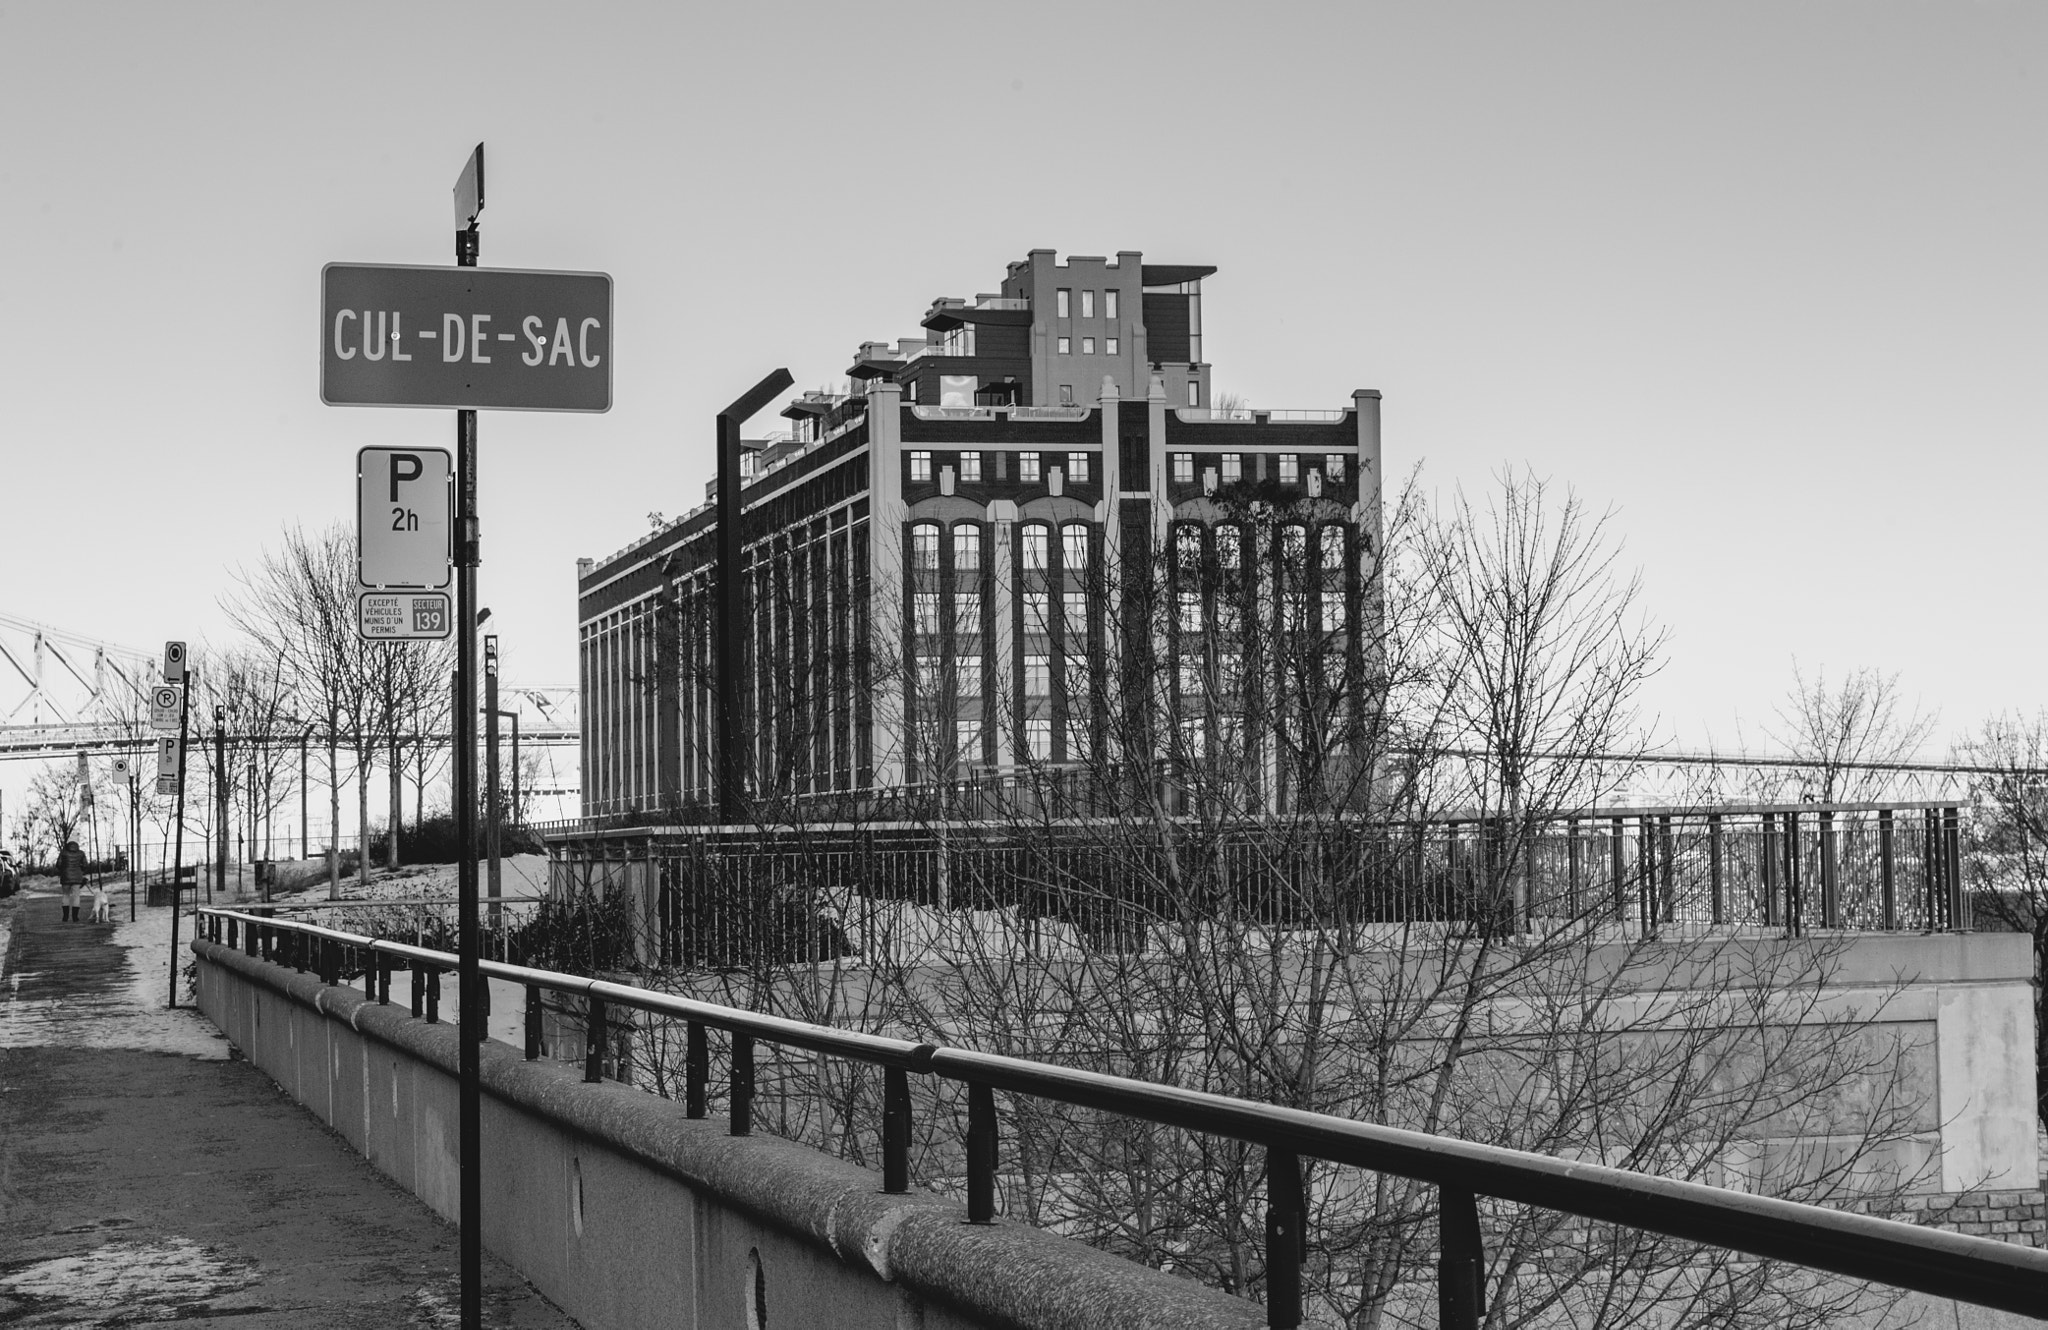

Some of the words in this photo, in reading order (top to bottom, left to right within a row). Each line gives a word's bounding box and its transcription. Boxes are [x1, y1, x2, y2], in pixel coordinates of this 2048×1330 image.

[334, 309, 601, 368] CUL-DE-SAC
[390, 453, 423, 502] P
[391, 507, 419, 531] 2h
[367, 597, 399, 607] EXCEPTÉ
[413, 600, 443, 610] SECTEUR
[365, 606, 402, 616] VÉHICULES
[364, 617, 385, 625] MUNIS
[386, 617, 403, 625] D'UN
[415, 612, 441, 630] 139
[371, 626, 396, 634] PERMIS
[166, 739, 175, 754] P
